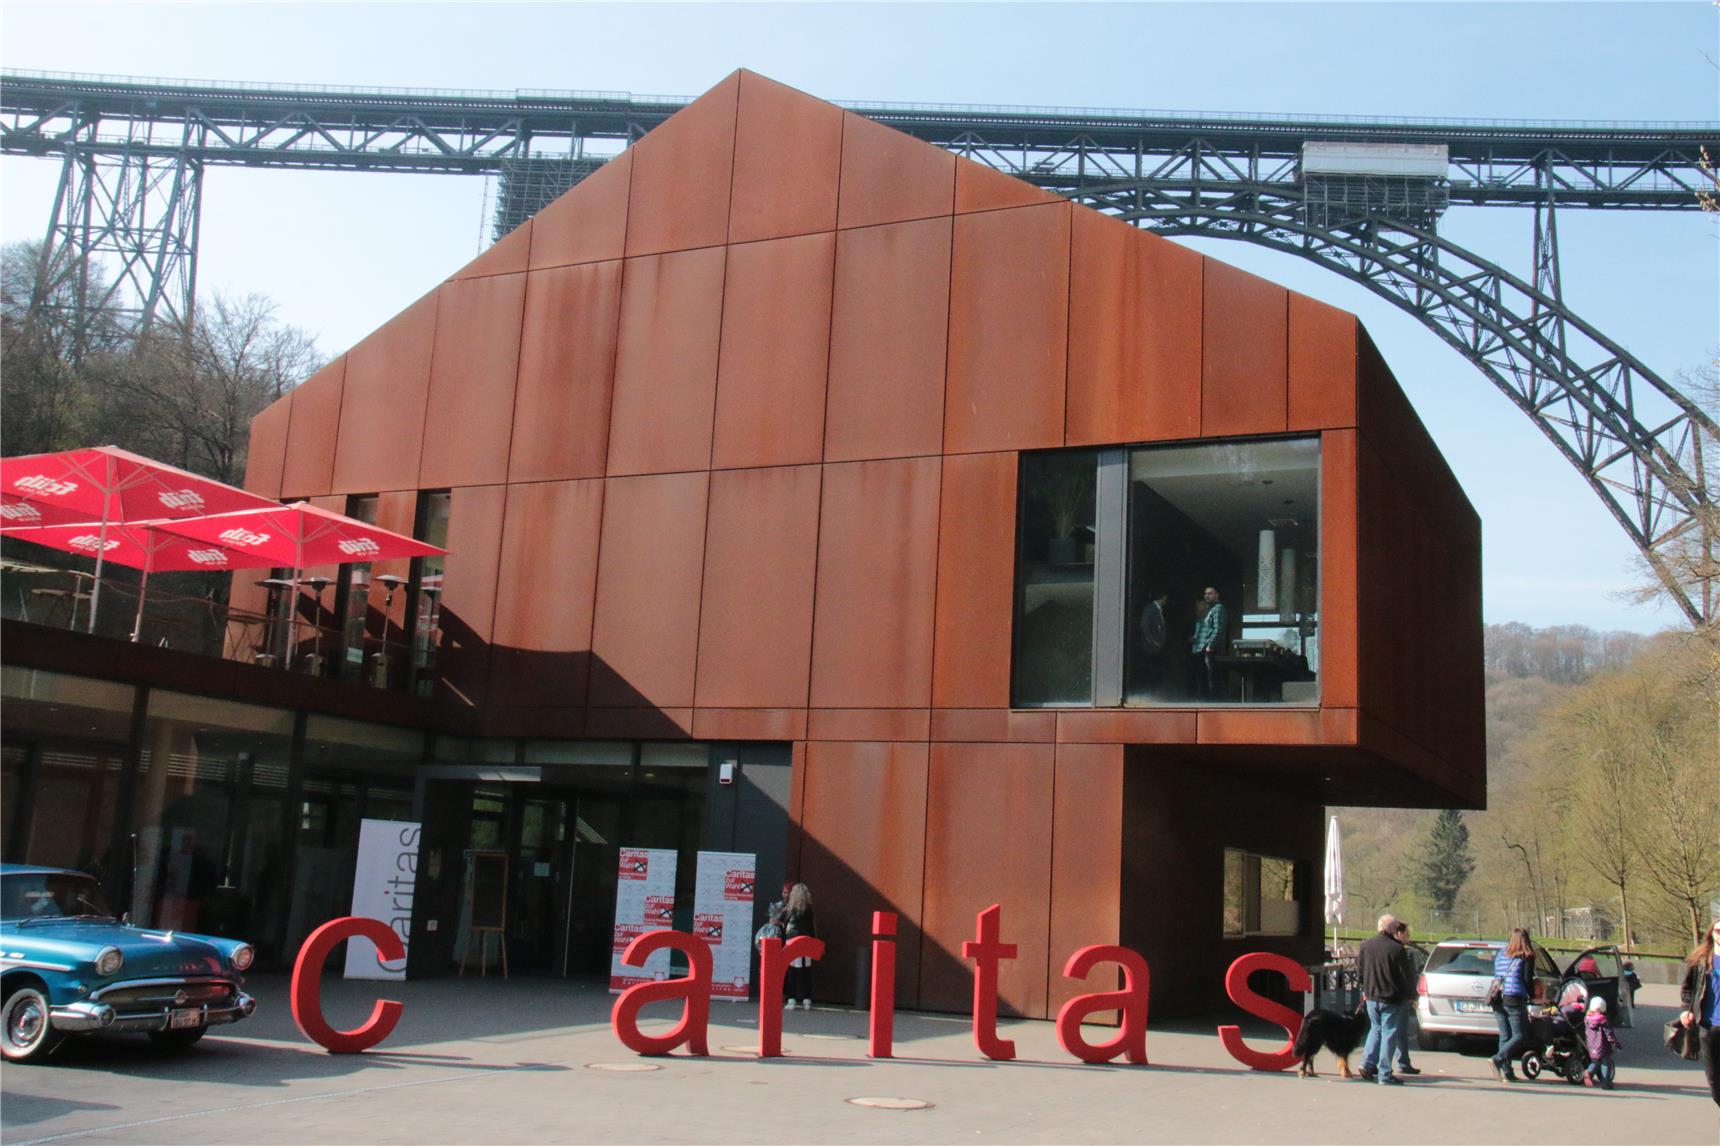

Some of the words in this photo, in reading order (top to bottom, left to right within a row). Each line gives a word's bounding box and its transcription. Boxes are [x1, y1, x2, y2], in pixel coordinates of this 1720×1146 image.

[619, 849, 648, 858] Caritas
[726, 870, 755, 878] Caritas
[645, 896, 674, 904] Caritas
[694, 913, 723, 921] Caritas
[290, 903, 1313, 1072] caritas
